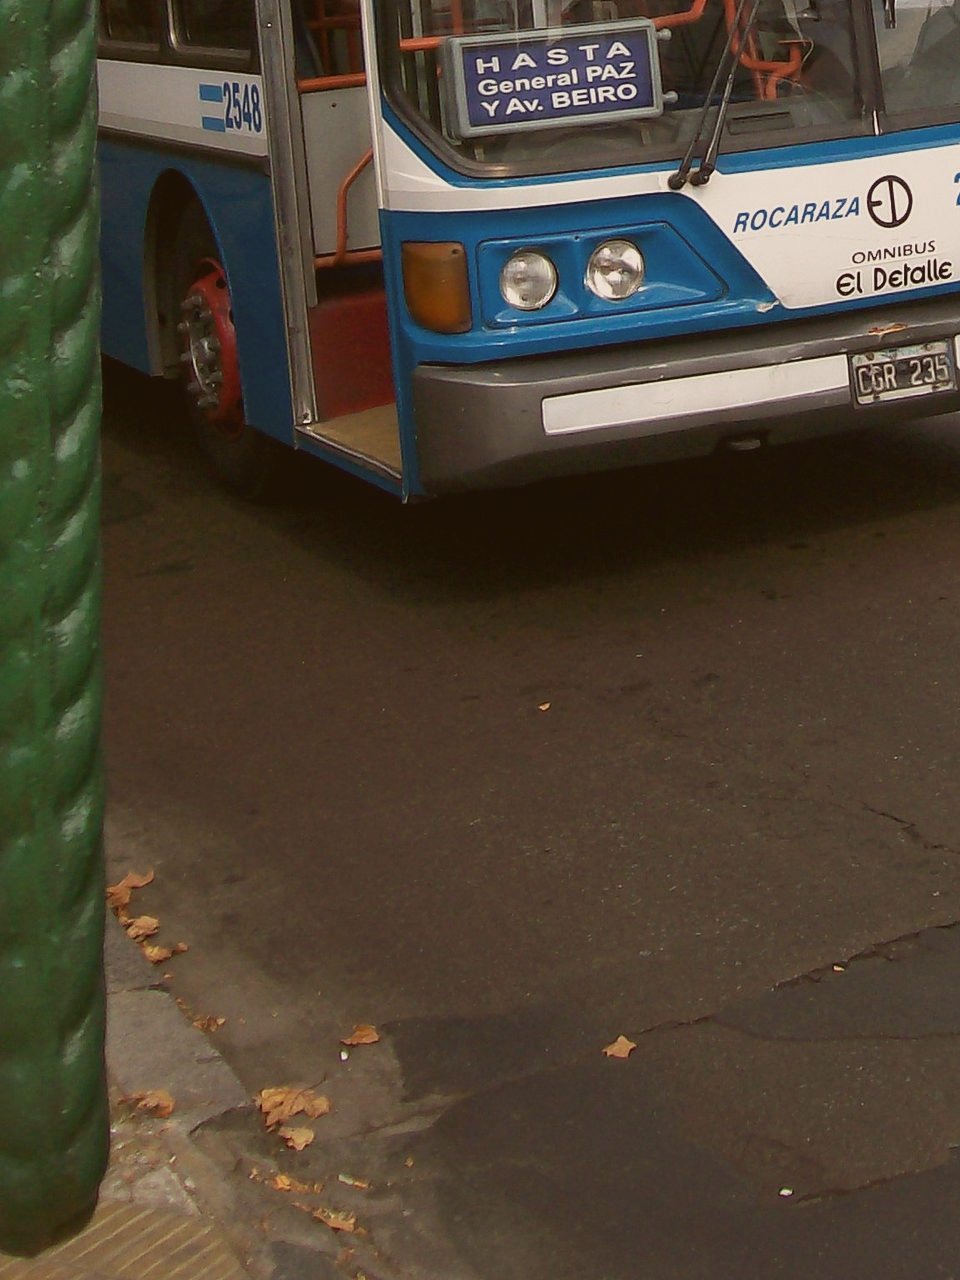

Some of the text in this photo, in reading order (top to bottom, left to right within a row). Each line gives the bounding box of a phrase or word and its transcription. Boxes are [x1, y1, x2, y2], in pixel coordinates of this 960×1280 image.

[475, 41, 632, 75] HASTA
[477, 62, 637, 97] General PAZ
[223, 81, 262, 133] 2548
[480, 83, 638, 118] Y Av. BEIRO
[733, 196, 860, 234] ROCARAZA
[851, 240, 936, 265] OMNIBUS
[836, 258, 953, 297] El Detalle
[858, 354, 950, 394] CGR 235
